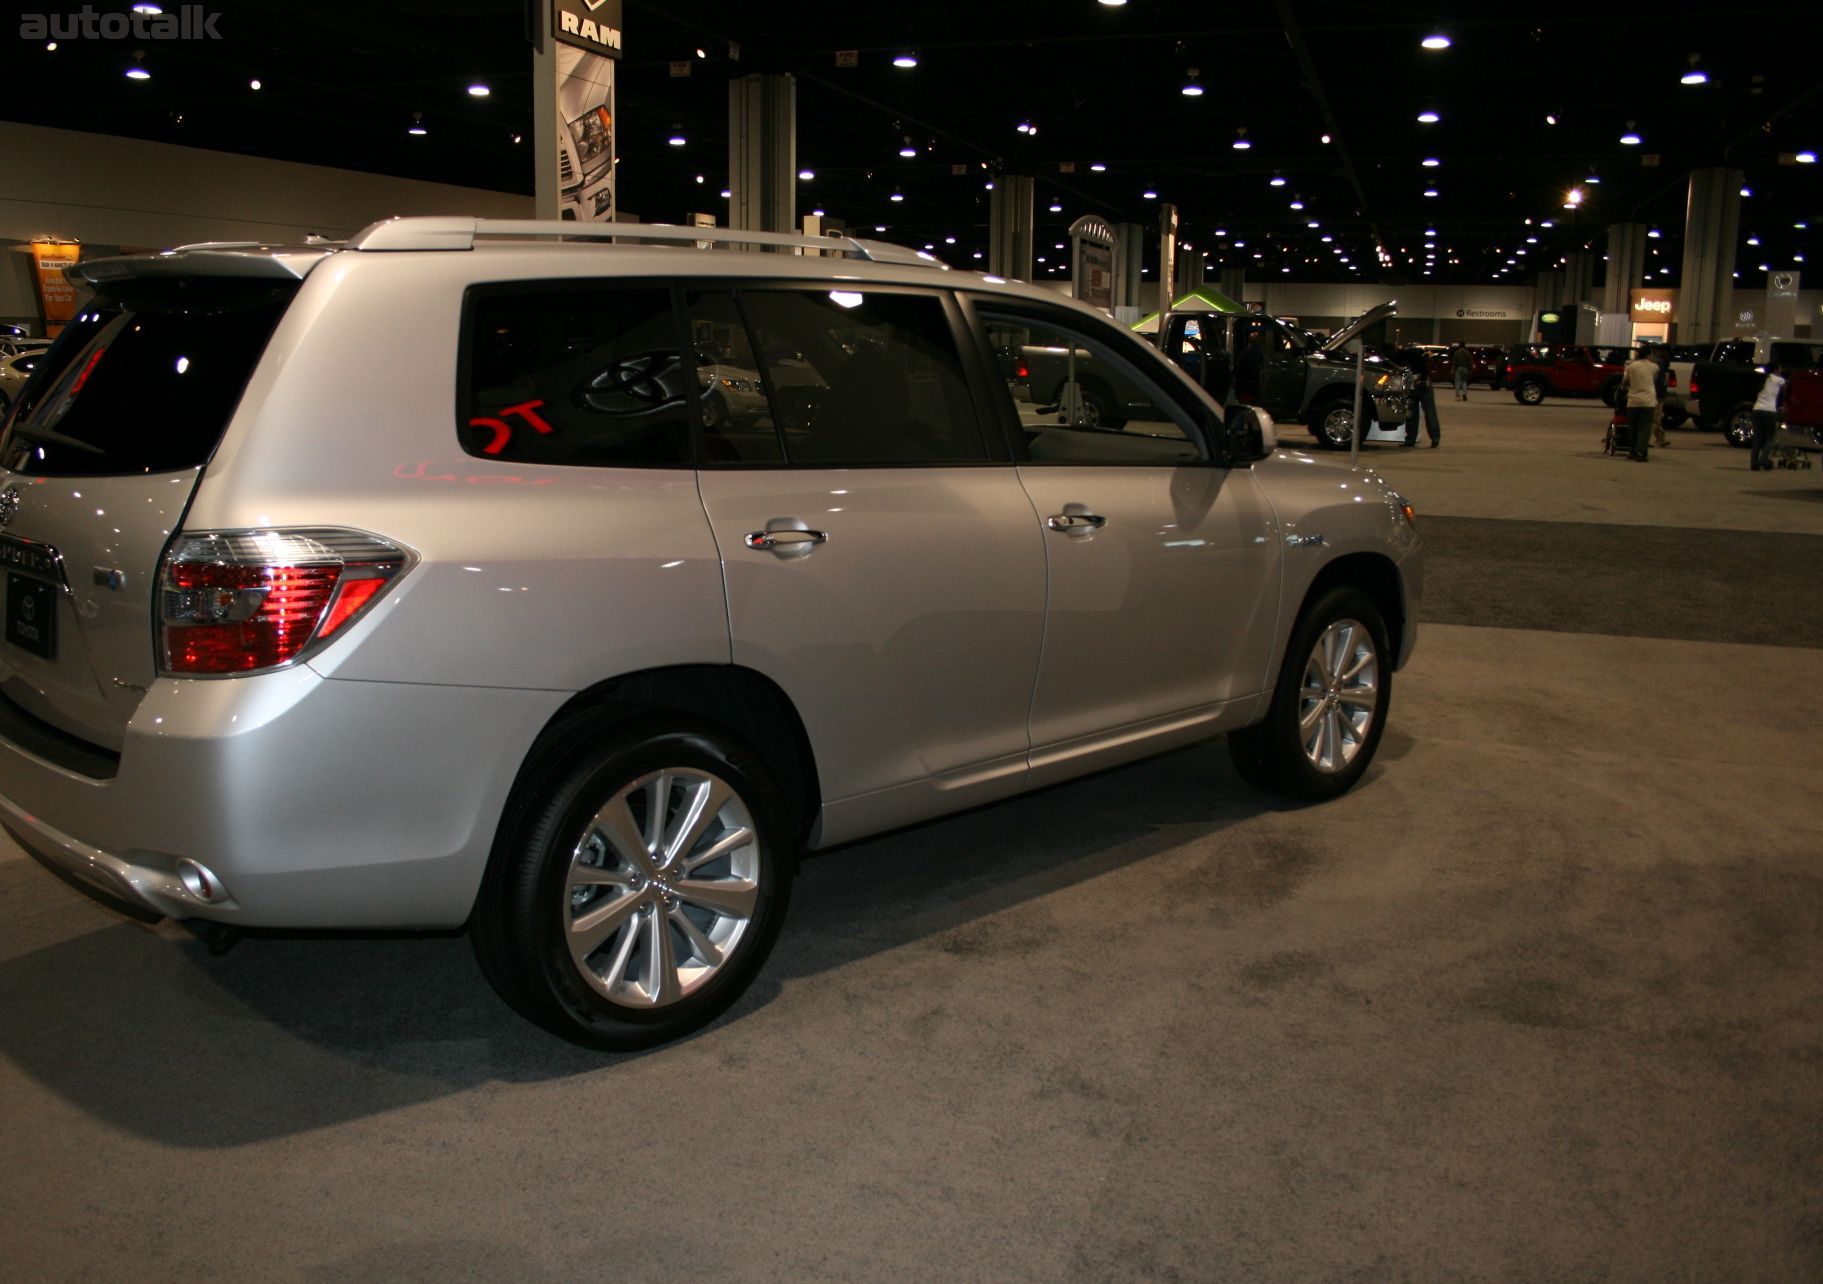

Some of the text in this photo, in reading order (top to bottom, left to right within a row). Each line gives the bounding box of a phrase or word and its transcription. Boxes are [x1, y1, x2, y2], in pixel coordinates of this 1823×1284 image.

[560, 10, 621, 50] RAM
[1634, 297, 1671, 312] Jeep
[1466, 309, 1506, 318] Restrooms
